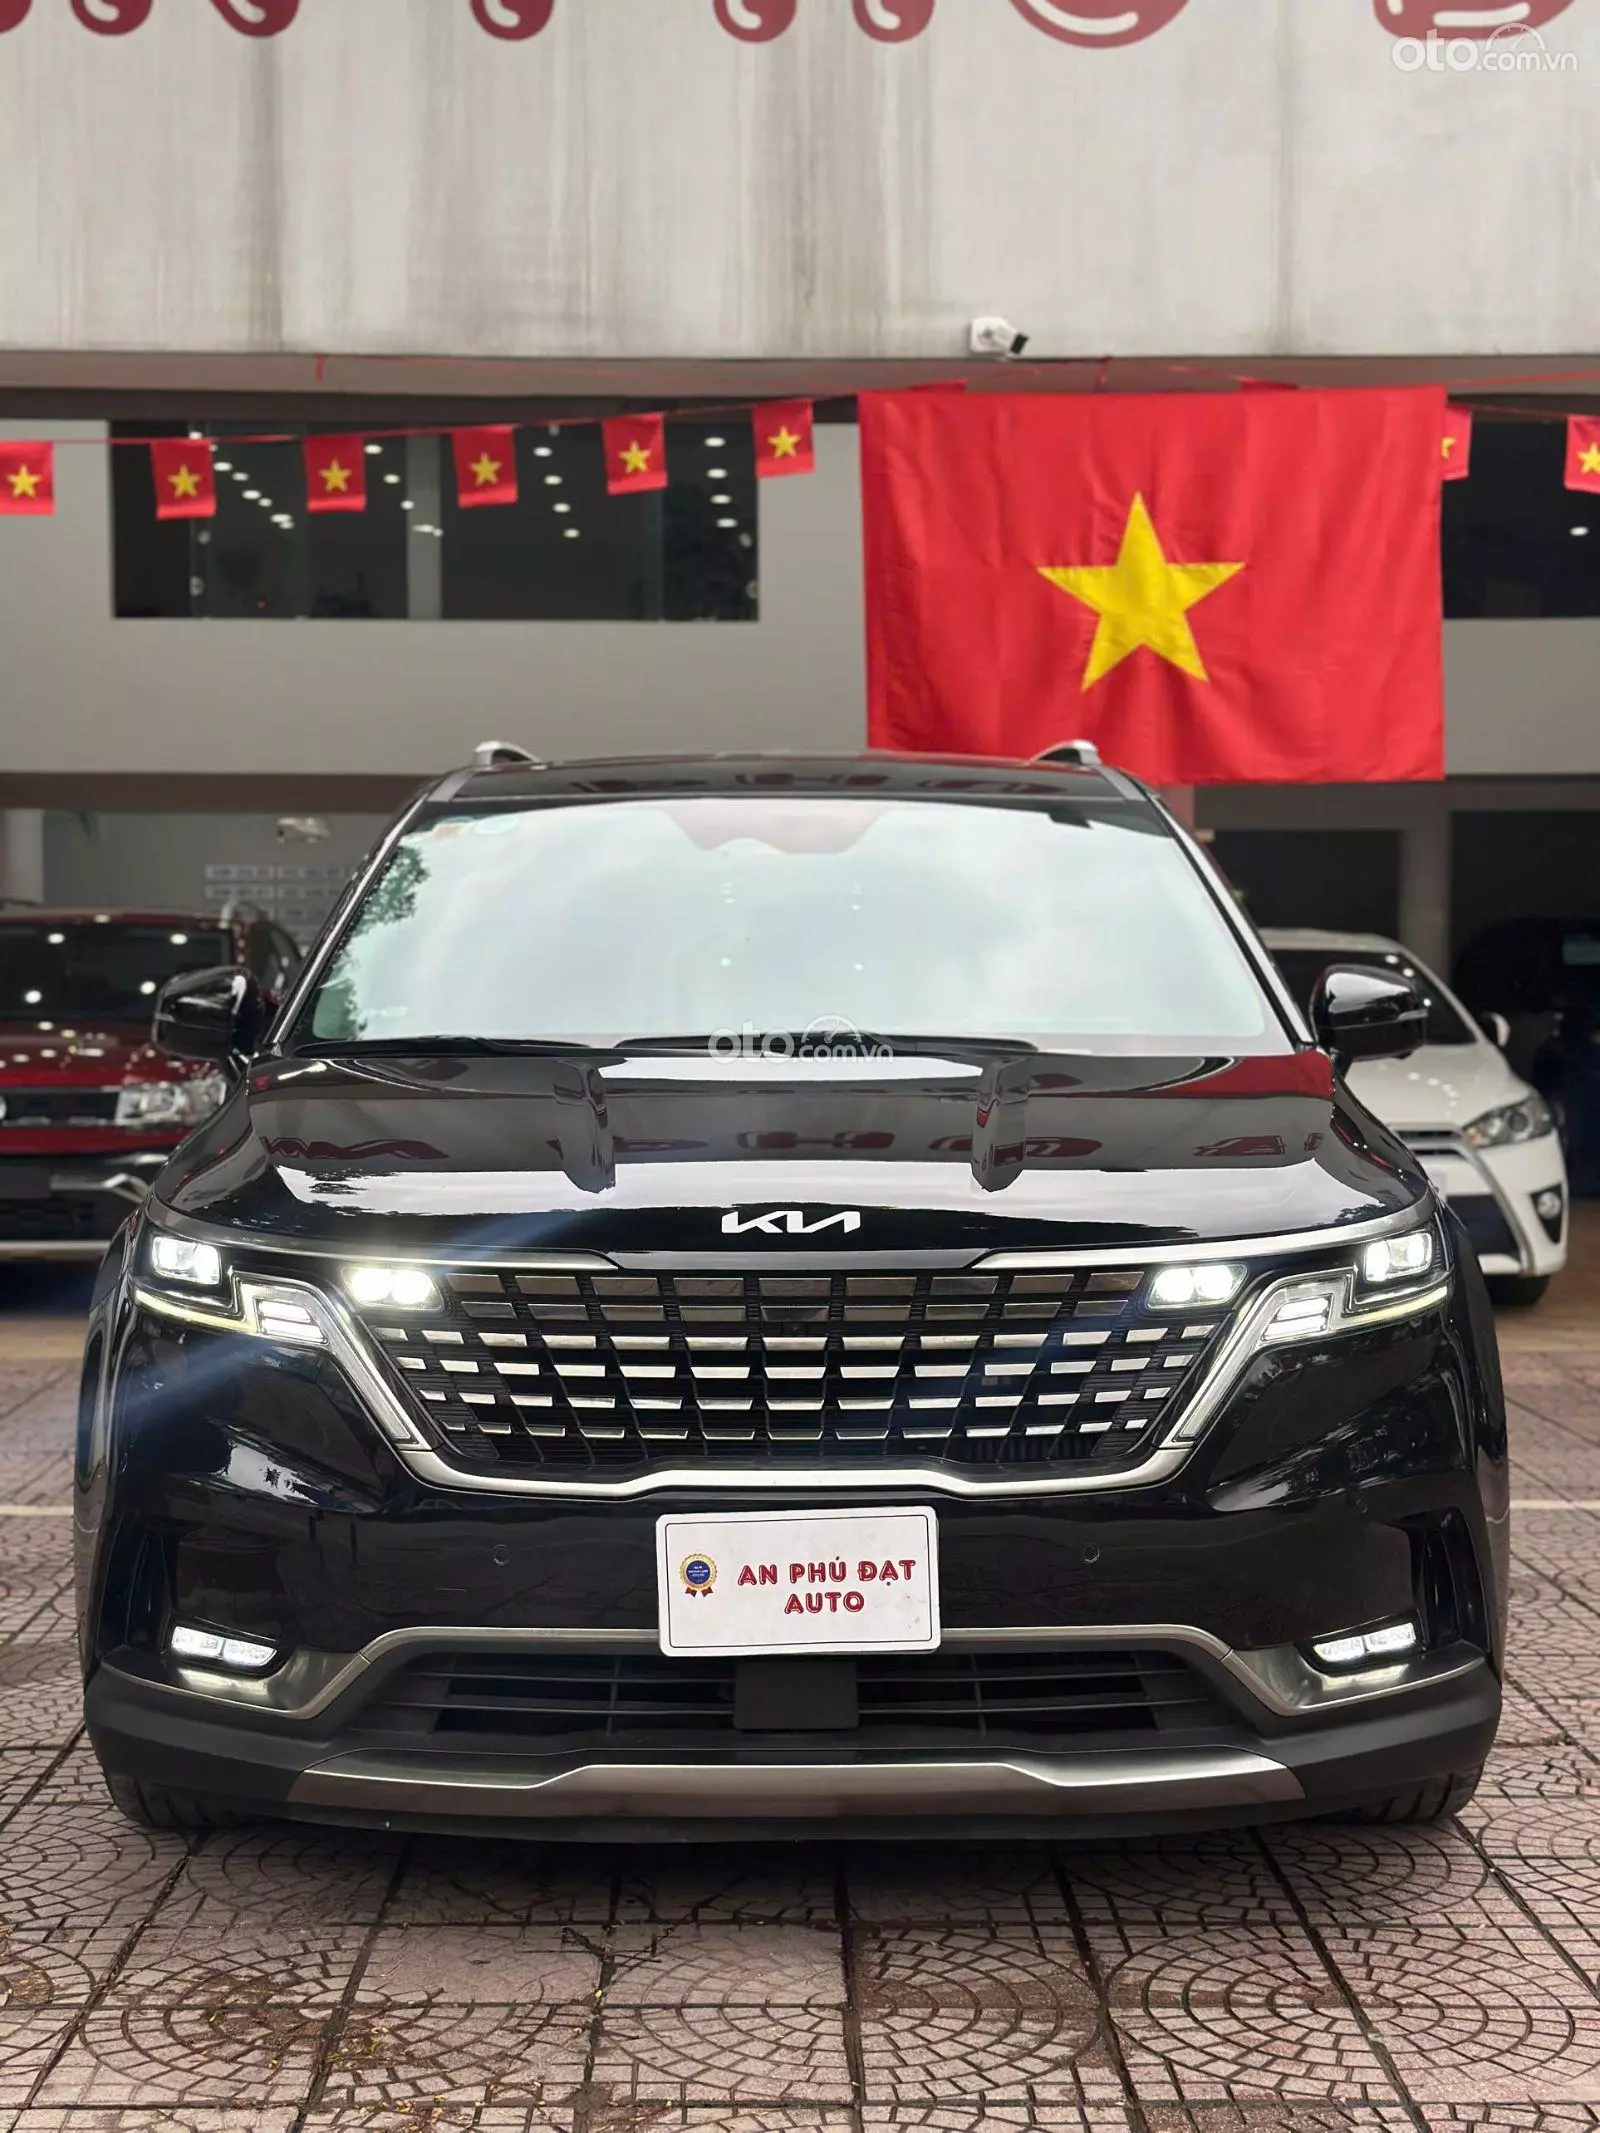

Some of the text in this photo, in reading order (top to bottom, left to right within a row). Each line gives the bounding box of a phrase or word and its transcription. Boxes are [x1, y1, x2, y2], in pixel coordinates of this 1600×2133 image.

[722, 1210, 861, 1234] KIA
[738, 1564, 779, 1586] AN
[789, 1556, 847, 1584] PHÚ
[857, 1559, 916, 1586] ĐẠT
[784, 1591, 865, 1614] AUTO
